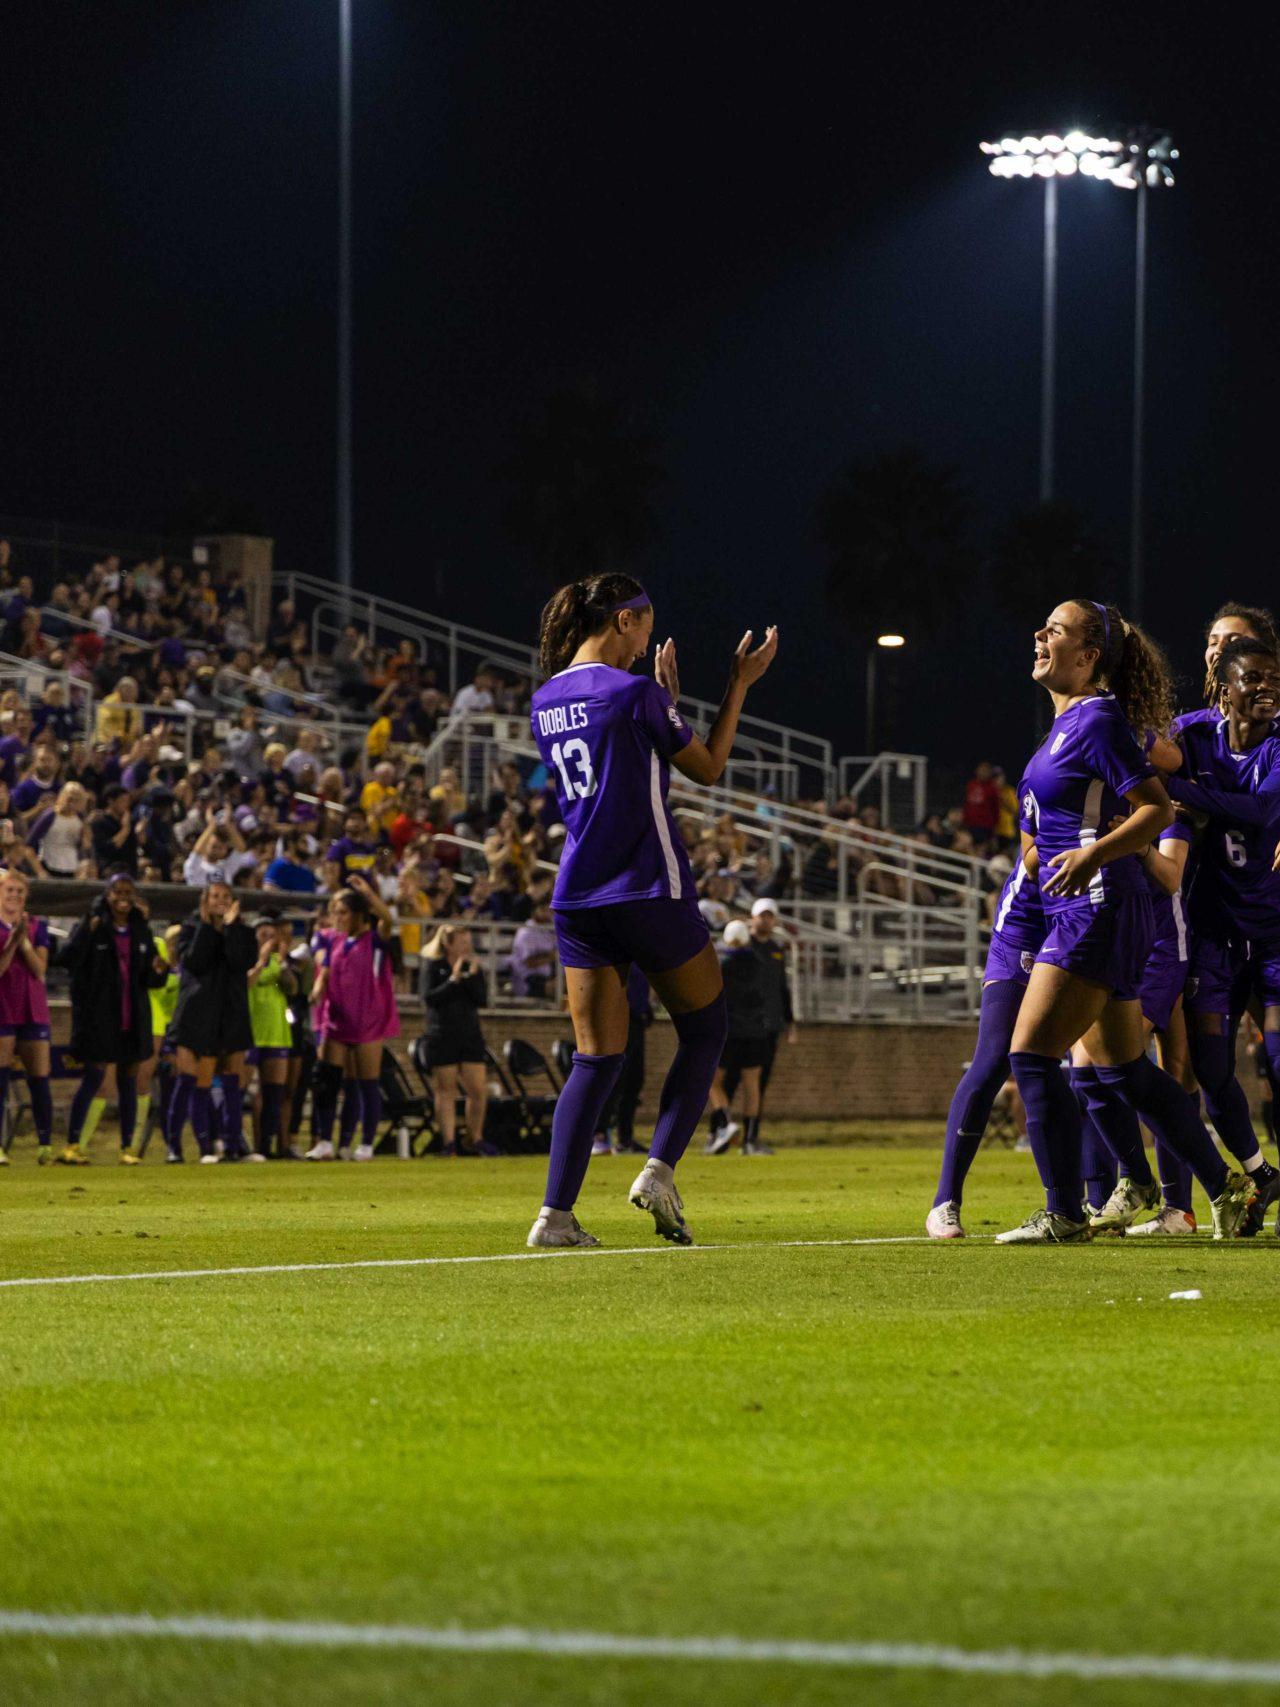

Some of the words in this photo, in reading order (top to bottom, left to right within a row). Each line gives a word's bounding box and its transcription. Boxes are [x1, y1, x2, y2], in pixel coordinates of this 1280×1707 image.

[538, 702, 588, 736] DOBLES
[551, 738, 598, 801] 13
[1225, 830, 1248, 868] 6
